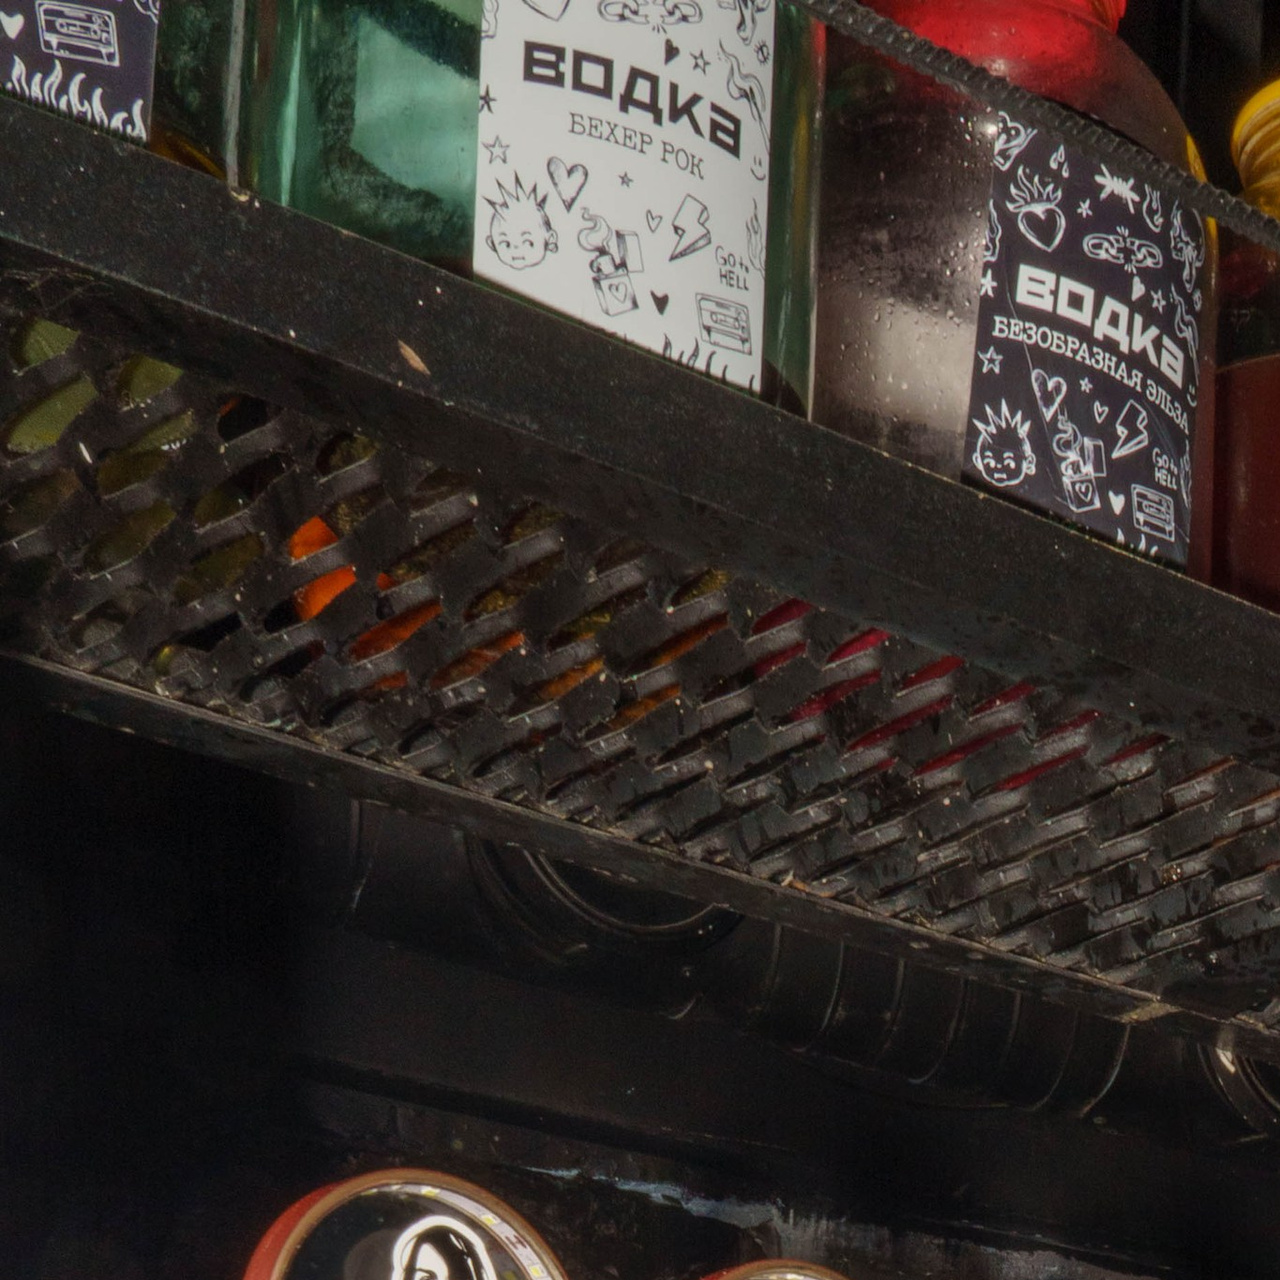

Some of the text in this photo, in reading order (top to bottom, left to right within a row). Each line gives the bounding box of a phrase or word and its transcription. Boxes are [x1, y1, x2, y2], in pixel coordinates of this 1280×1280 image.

[568, 111, 704, 181] БЕХЕР РОК
[719, 269, 749, 291] HELL
[993, 315, 1189, 435] БЕЗОБРАЗНАЯ ЭЛЬЗА
[1154, 467, 1178, 490] HELL
